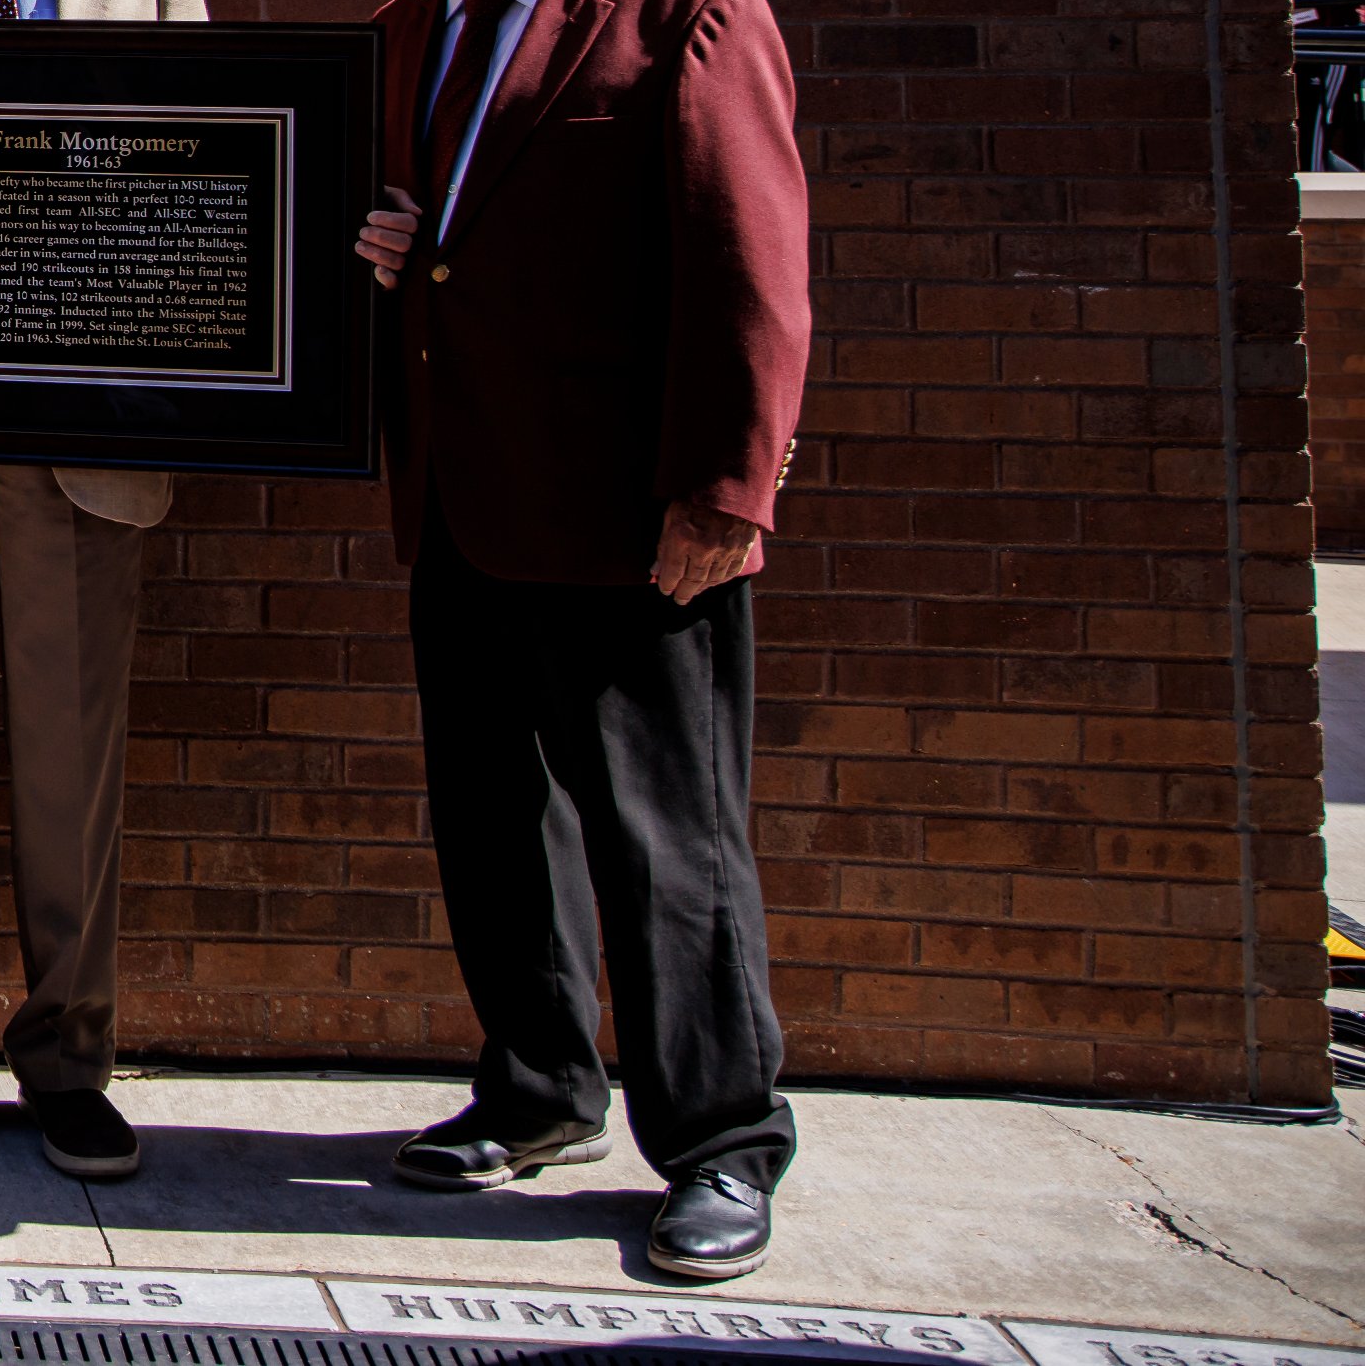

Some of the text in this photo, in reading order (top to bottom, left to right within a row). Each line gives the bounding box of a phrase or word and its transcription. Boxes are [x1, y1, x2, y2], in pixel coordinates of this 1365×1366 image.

[59, 131, 200, 157] Montgomery
[66, 155, 121, 169] 1961-63
[22, 176, 44, 187] who
[46, 177, 84, 187] became
[86, 177, 103, 188] the
[105, 178, 126, 188] first
[128, 178, 166, 191] pitcher
[168, 179, 178, 189] in
[180, 179, 207, 189] MSU
[210, 179, 247, 192] history
[33, 191, 43, 201] in
[57, 194, 90, 202] season
[95, 192, 118, 202] with
[133, 192, 168, 206] perfect
[174, 193, 194, 203] 10-0
[199, 194, 233, 204] record
[237, 194, 247, 204] in
[381, 1293, 966, 1352] HUMPHREYS
